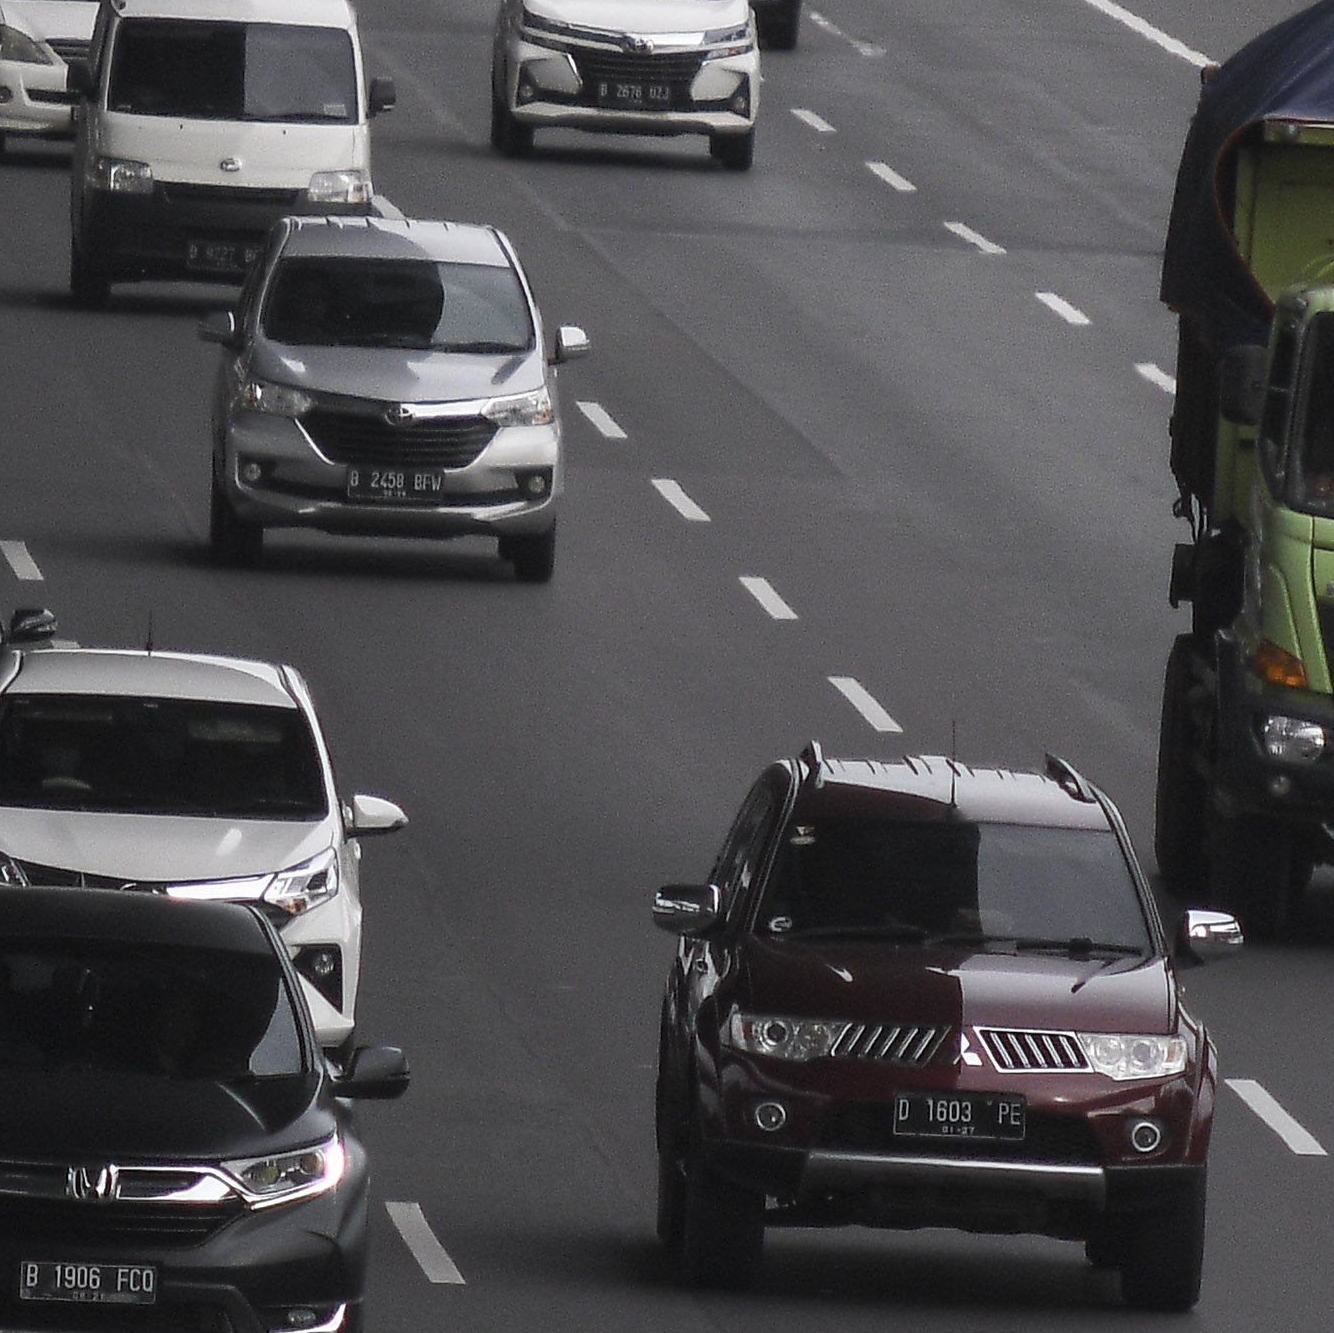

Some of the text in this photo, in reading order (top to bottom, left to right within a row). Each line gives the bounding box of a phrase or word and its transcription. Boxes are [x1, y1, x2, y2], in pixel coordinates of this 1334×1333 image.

[350, 470, 359, 487] B
[370, 471, 405, 489] 2458
[898, 1098, 1021, 1126] D 1603 PE
[26, 1264, 38, 1287] B
[55, 1265, 100, 1290] 1906
